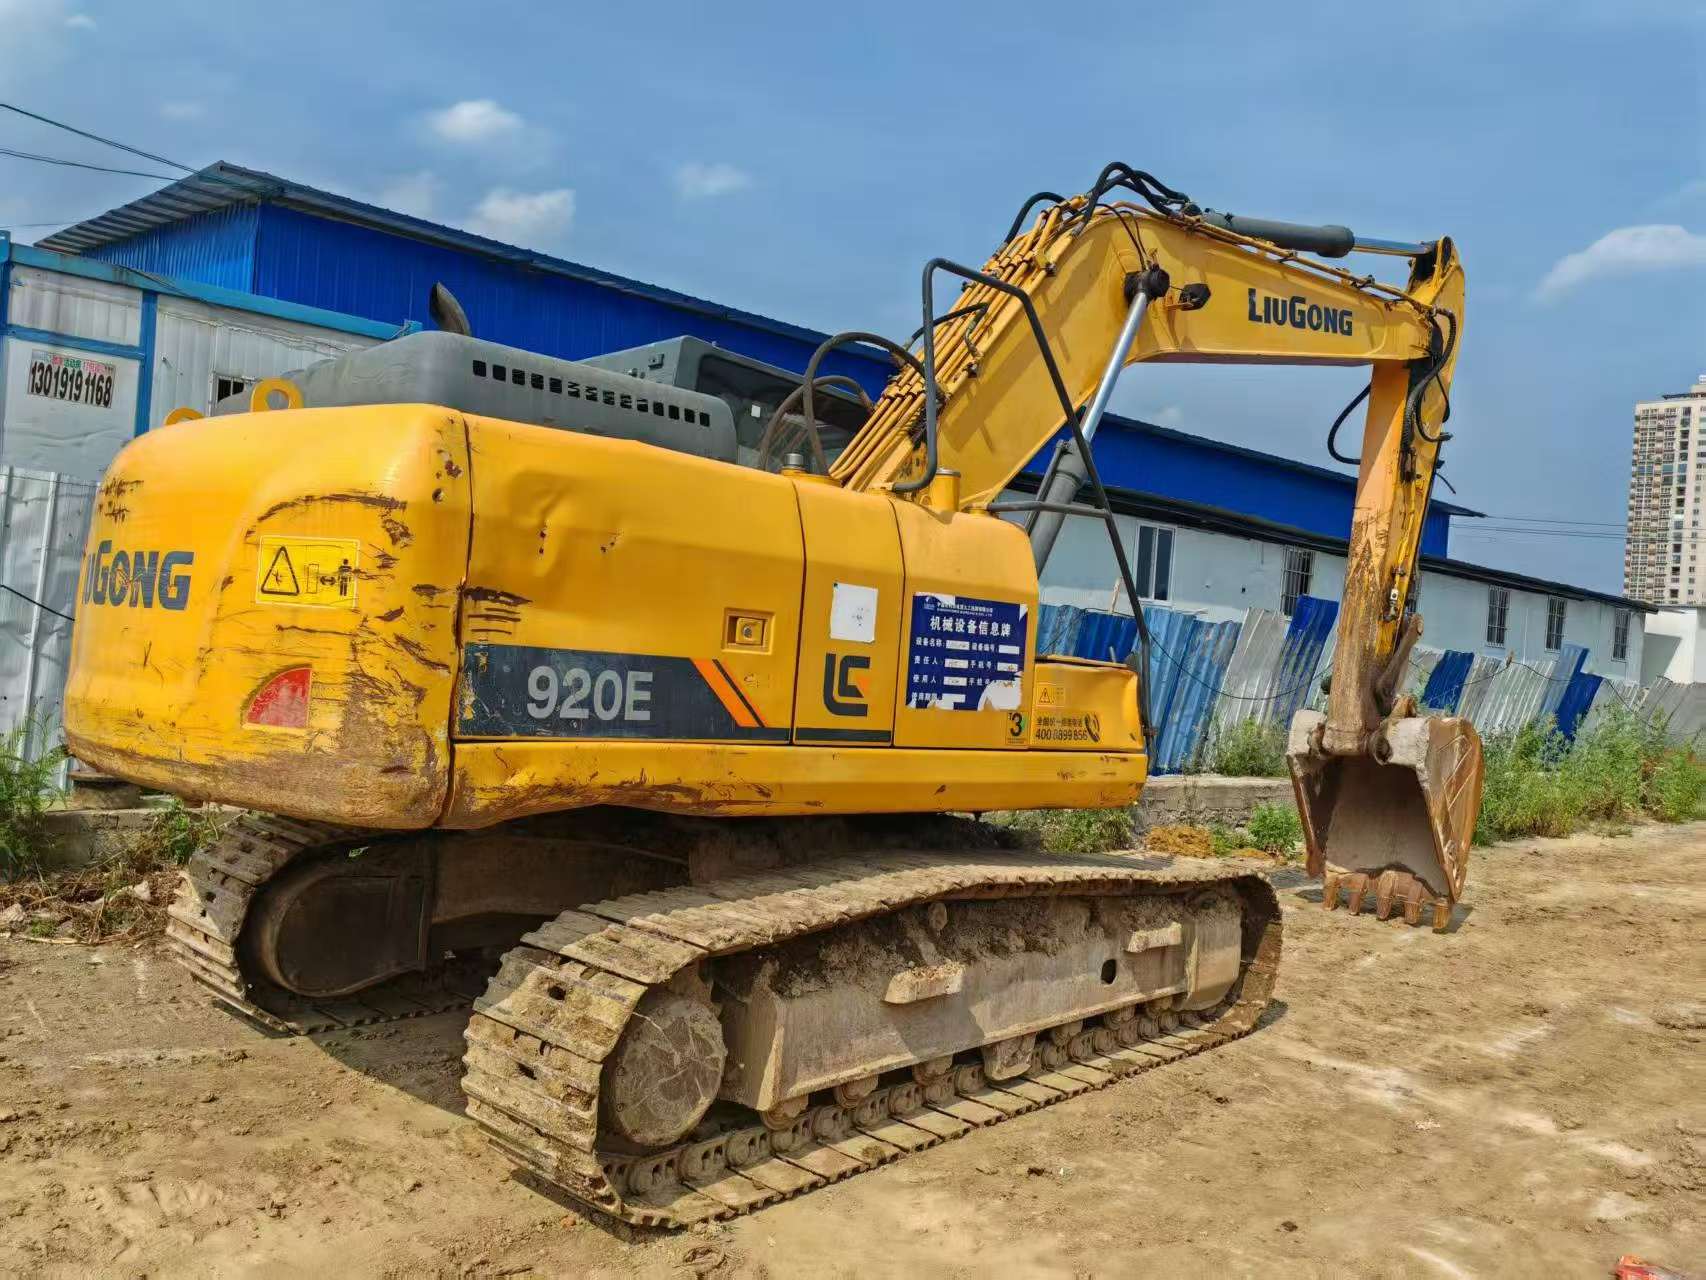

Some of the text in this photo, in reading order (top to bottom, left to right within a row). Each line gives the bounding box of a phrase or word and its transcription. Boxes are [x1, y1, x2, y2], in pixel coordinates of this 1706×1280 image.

[930, 616, 1011, 637] 机械设备信息牌
[527, 666, 653, 721] 920E
